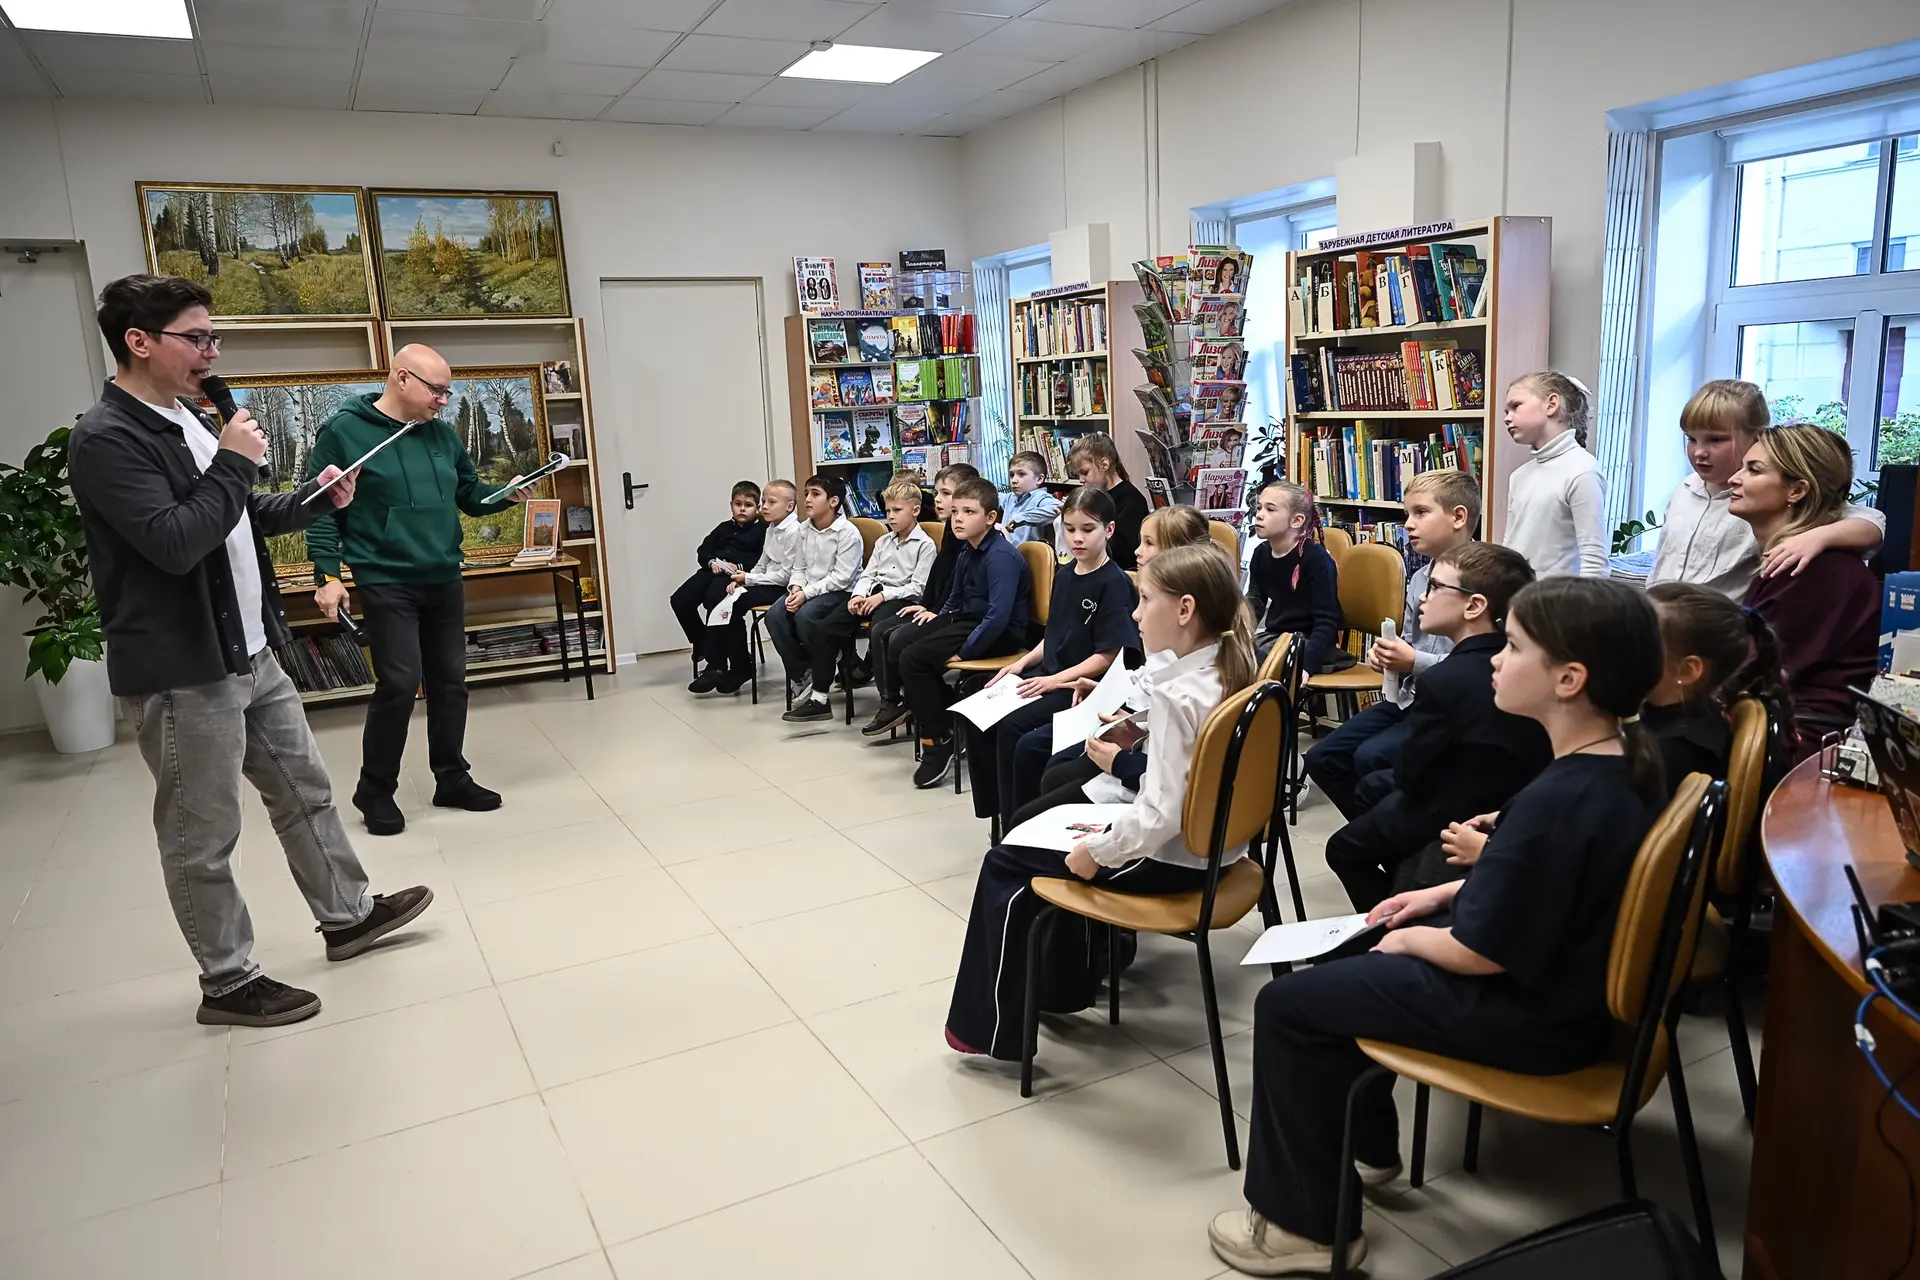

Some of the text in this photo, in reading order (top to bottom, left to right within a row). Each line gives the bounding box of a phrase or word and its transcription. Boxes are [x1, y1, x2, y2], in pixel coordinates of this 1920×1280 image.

[1320, 221, 1453, 251] ЗАРУБЕЖНАЯ ДЕТСКАЯ ЛИТЕРАТУРА
[1378, 276, 1387, 288] В
[1402, 275, 1410, 289] Г
[806, 277, 832, 300] 80
[1320, 285, 1330, 297] Б
[1291, 290, 1300, 300] А
[1435, 358, 1445, 371] К
[1316, 450, 1325, 461] Л
[1402, 453, 1412, 464] М
[1445, 455, 1455, 468] Н
[1202, 472, 1233, 484] Маруся
[1360, 534, 1367, 544] Р
